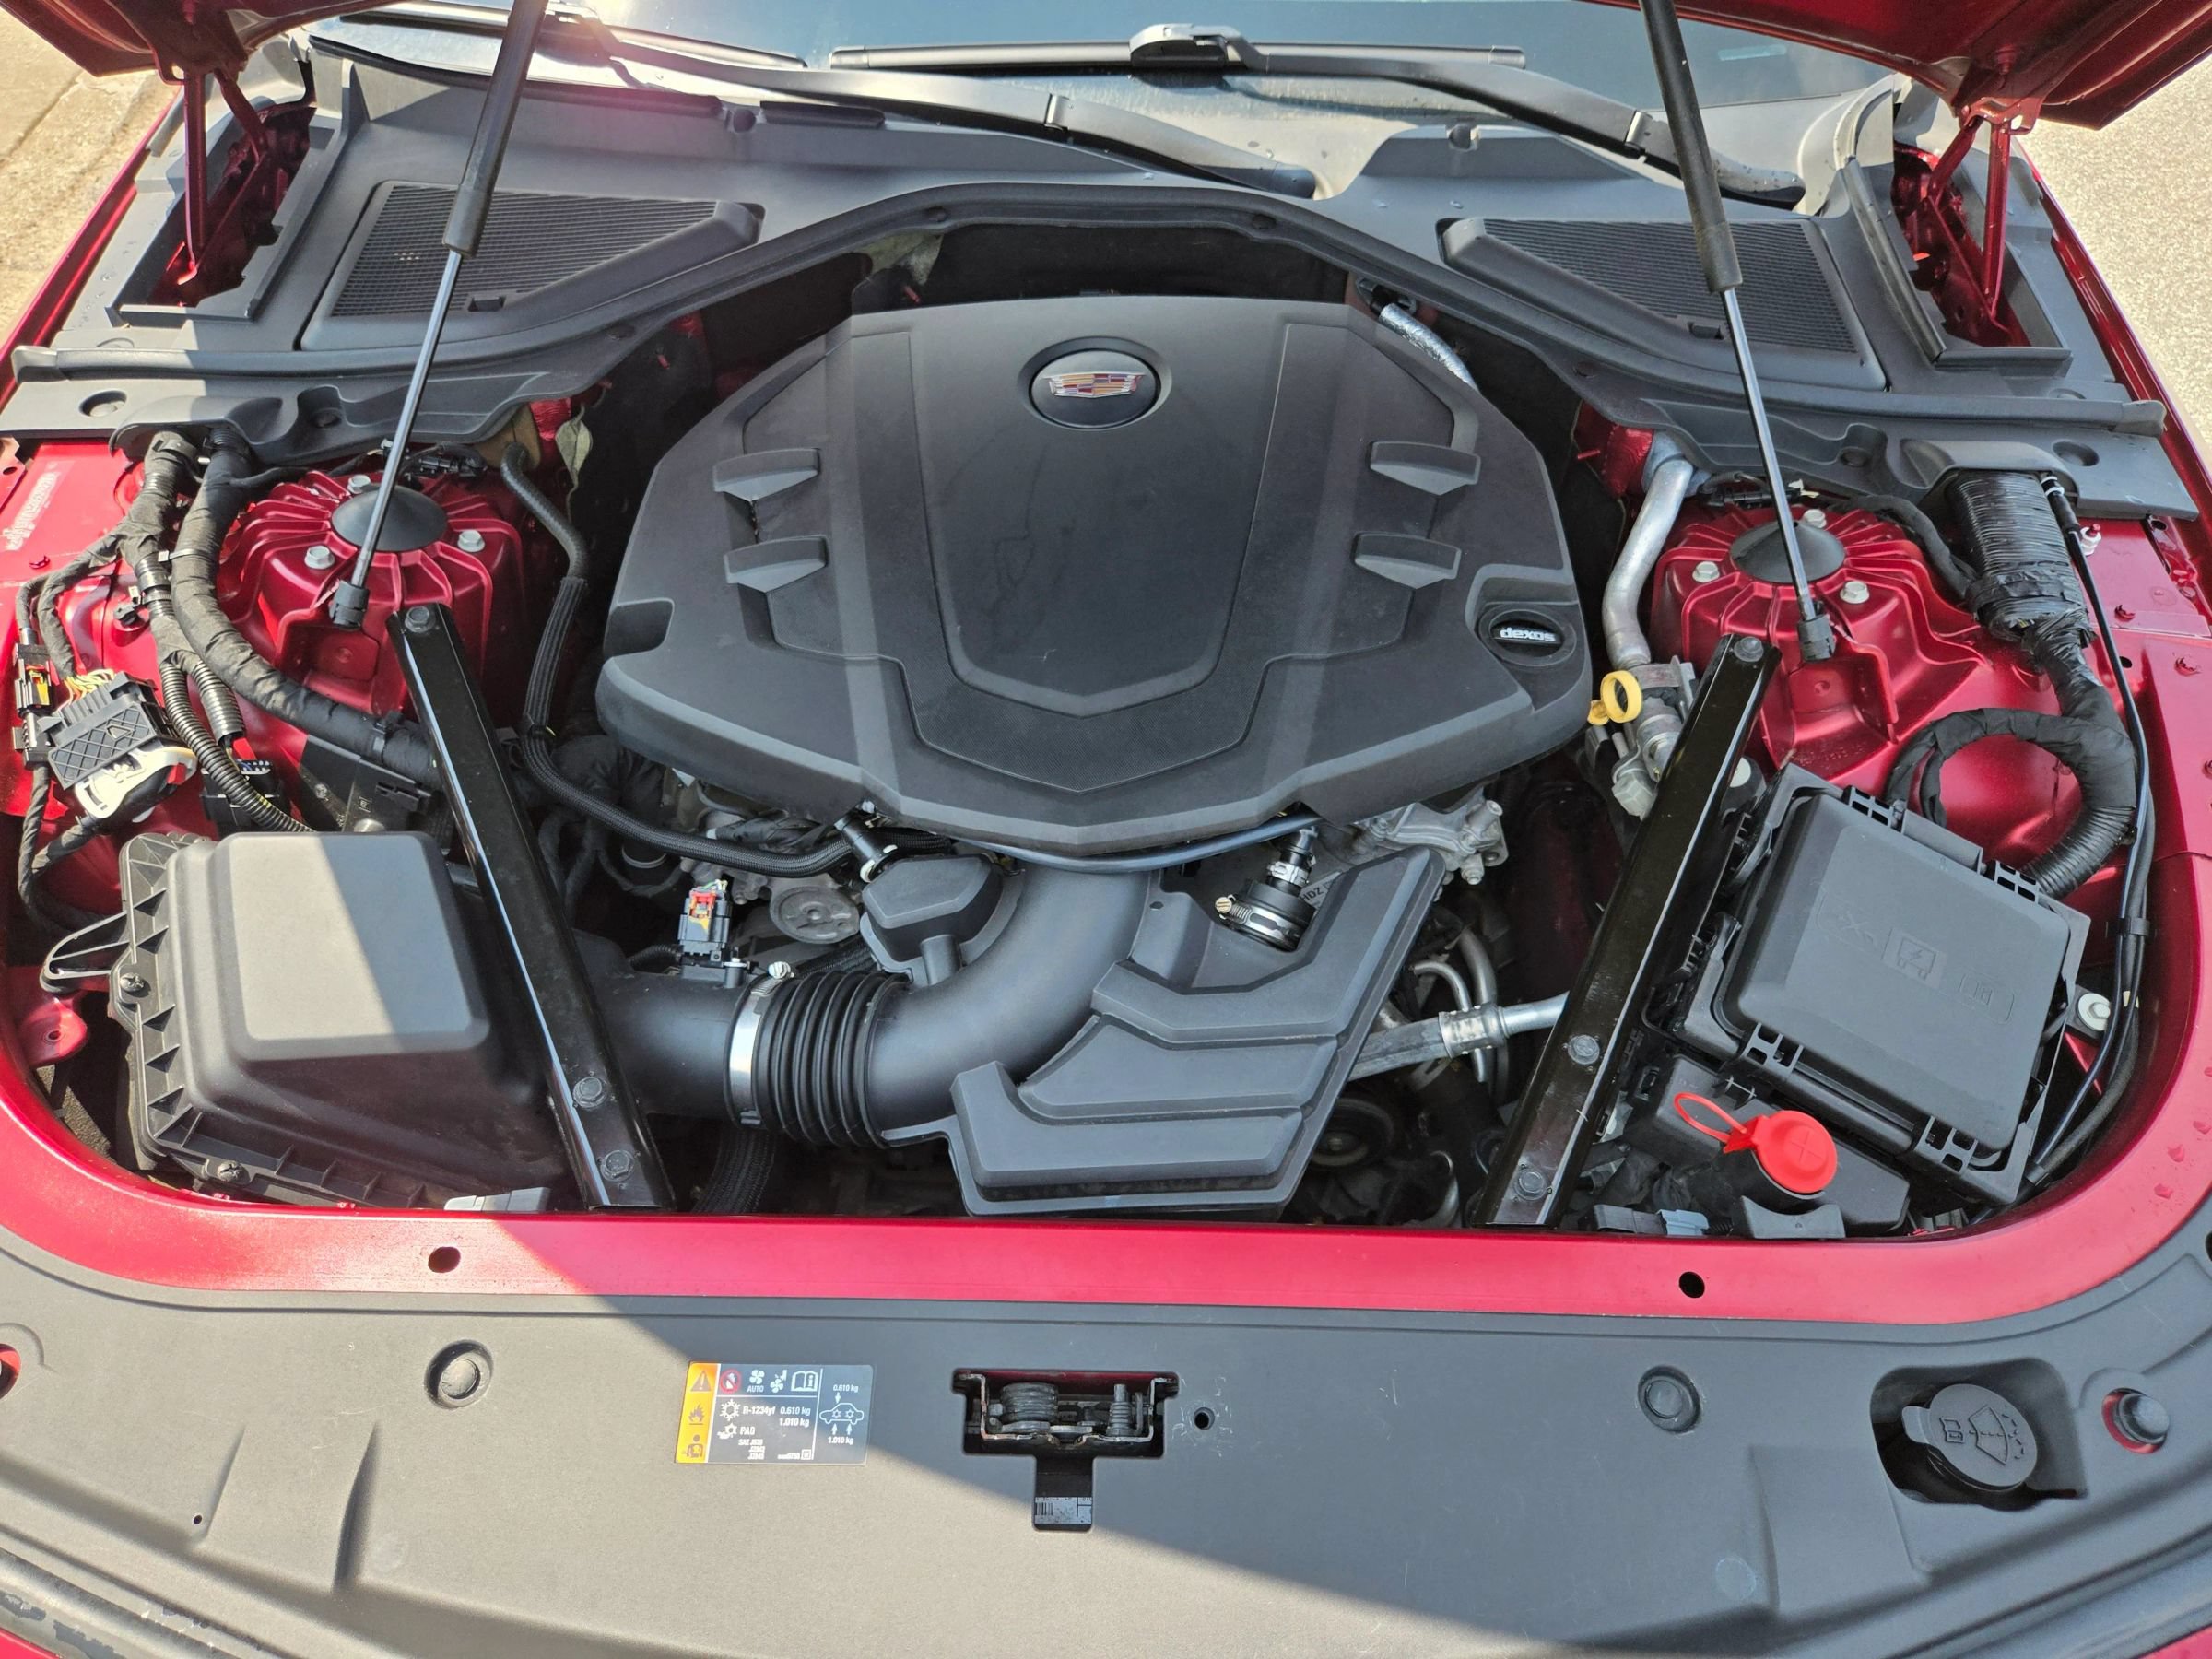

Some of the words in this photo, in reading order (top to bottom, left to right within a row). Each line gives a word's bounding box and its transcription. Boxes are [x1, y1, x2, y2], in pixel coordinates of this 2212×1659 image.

[1500, 626, 1556, 642] dexos
[832, 1383, 850, 1392] 0.610
[850, 1383, 859, 1393] kg
[742, 1406, 776, 1417] R-1234yf
[780, 1406, 800, 1415] 0.610
[801, 1406, 811, 1417] kg
[779, 1418, 799, 1426] 1.010
[799, 1418, 810, 1428] kg
[828, 1436, 845, 1444] 1.010
[845, 1436, 854, 1446] kg
